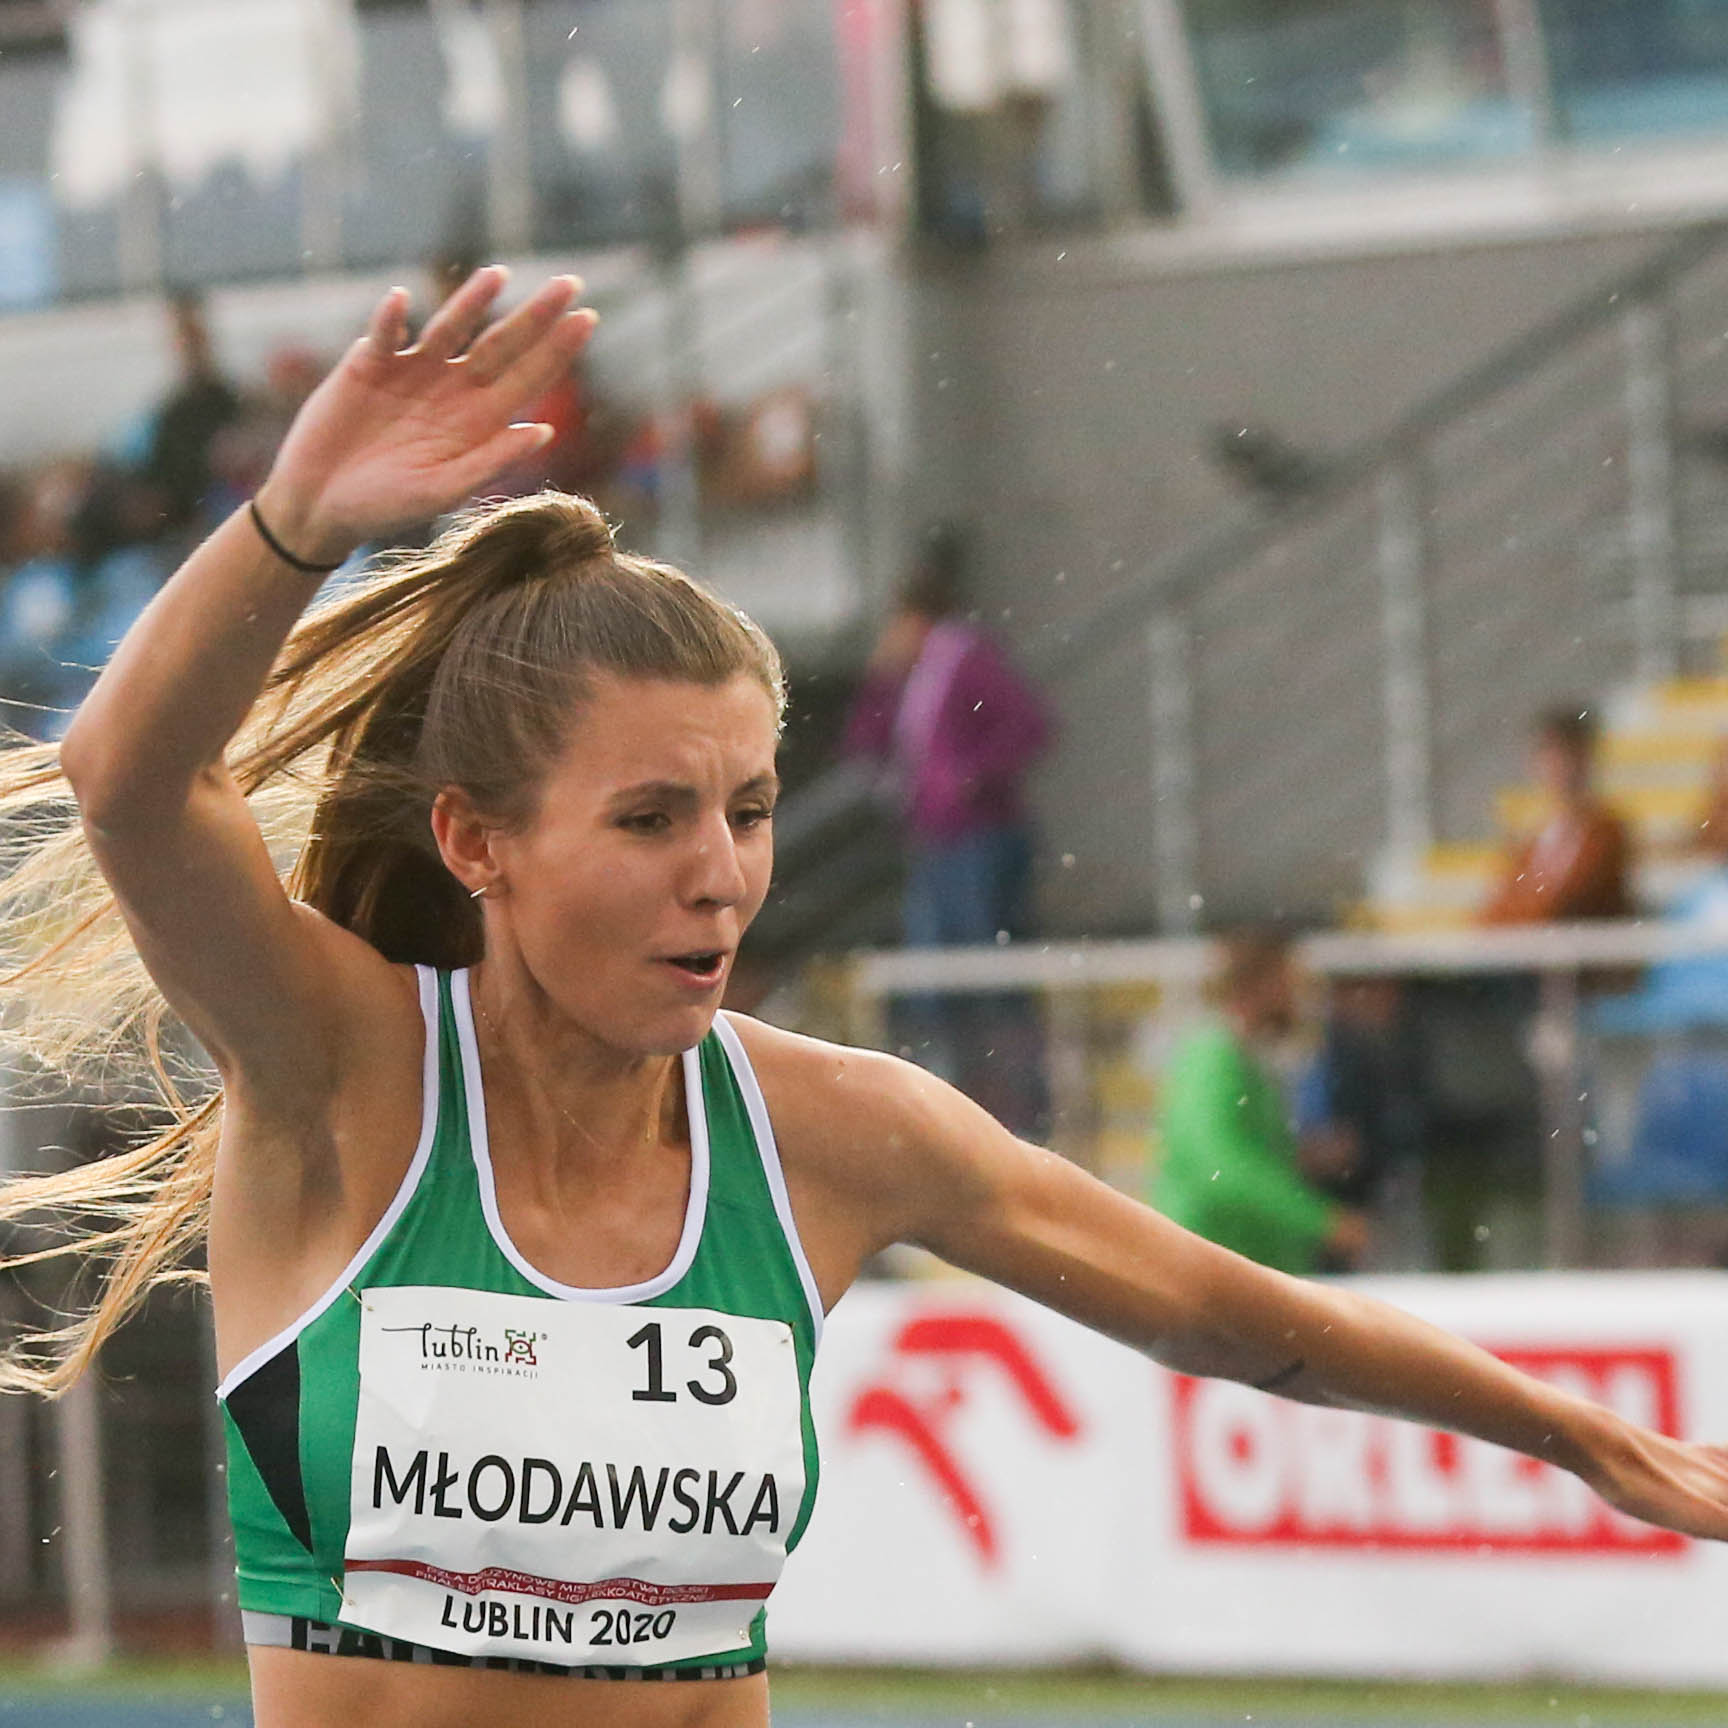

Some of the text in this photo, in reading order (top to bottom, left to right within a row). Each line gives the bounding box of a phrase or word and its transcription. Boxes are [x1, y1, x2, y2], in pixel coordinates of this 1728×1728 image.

[421, 1363, 539, 1379] MIASTO INSPIRACJI
[626, 1322, 738, 1405] 13
[373, 1445, 780, 1536] MŁODAWSKA
[441, 1594, 574, 1644] LUBLIN
[589, 1608, 676, 1646] 2020
